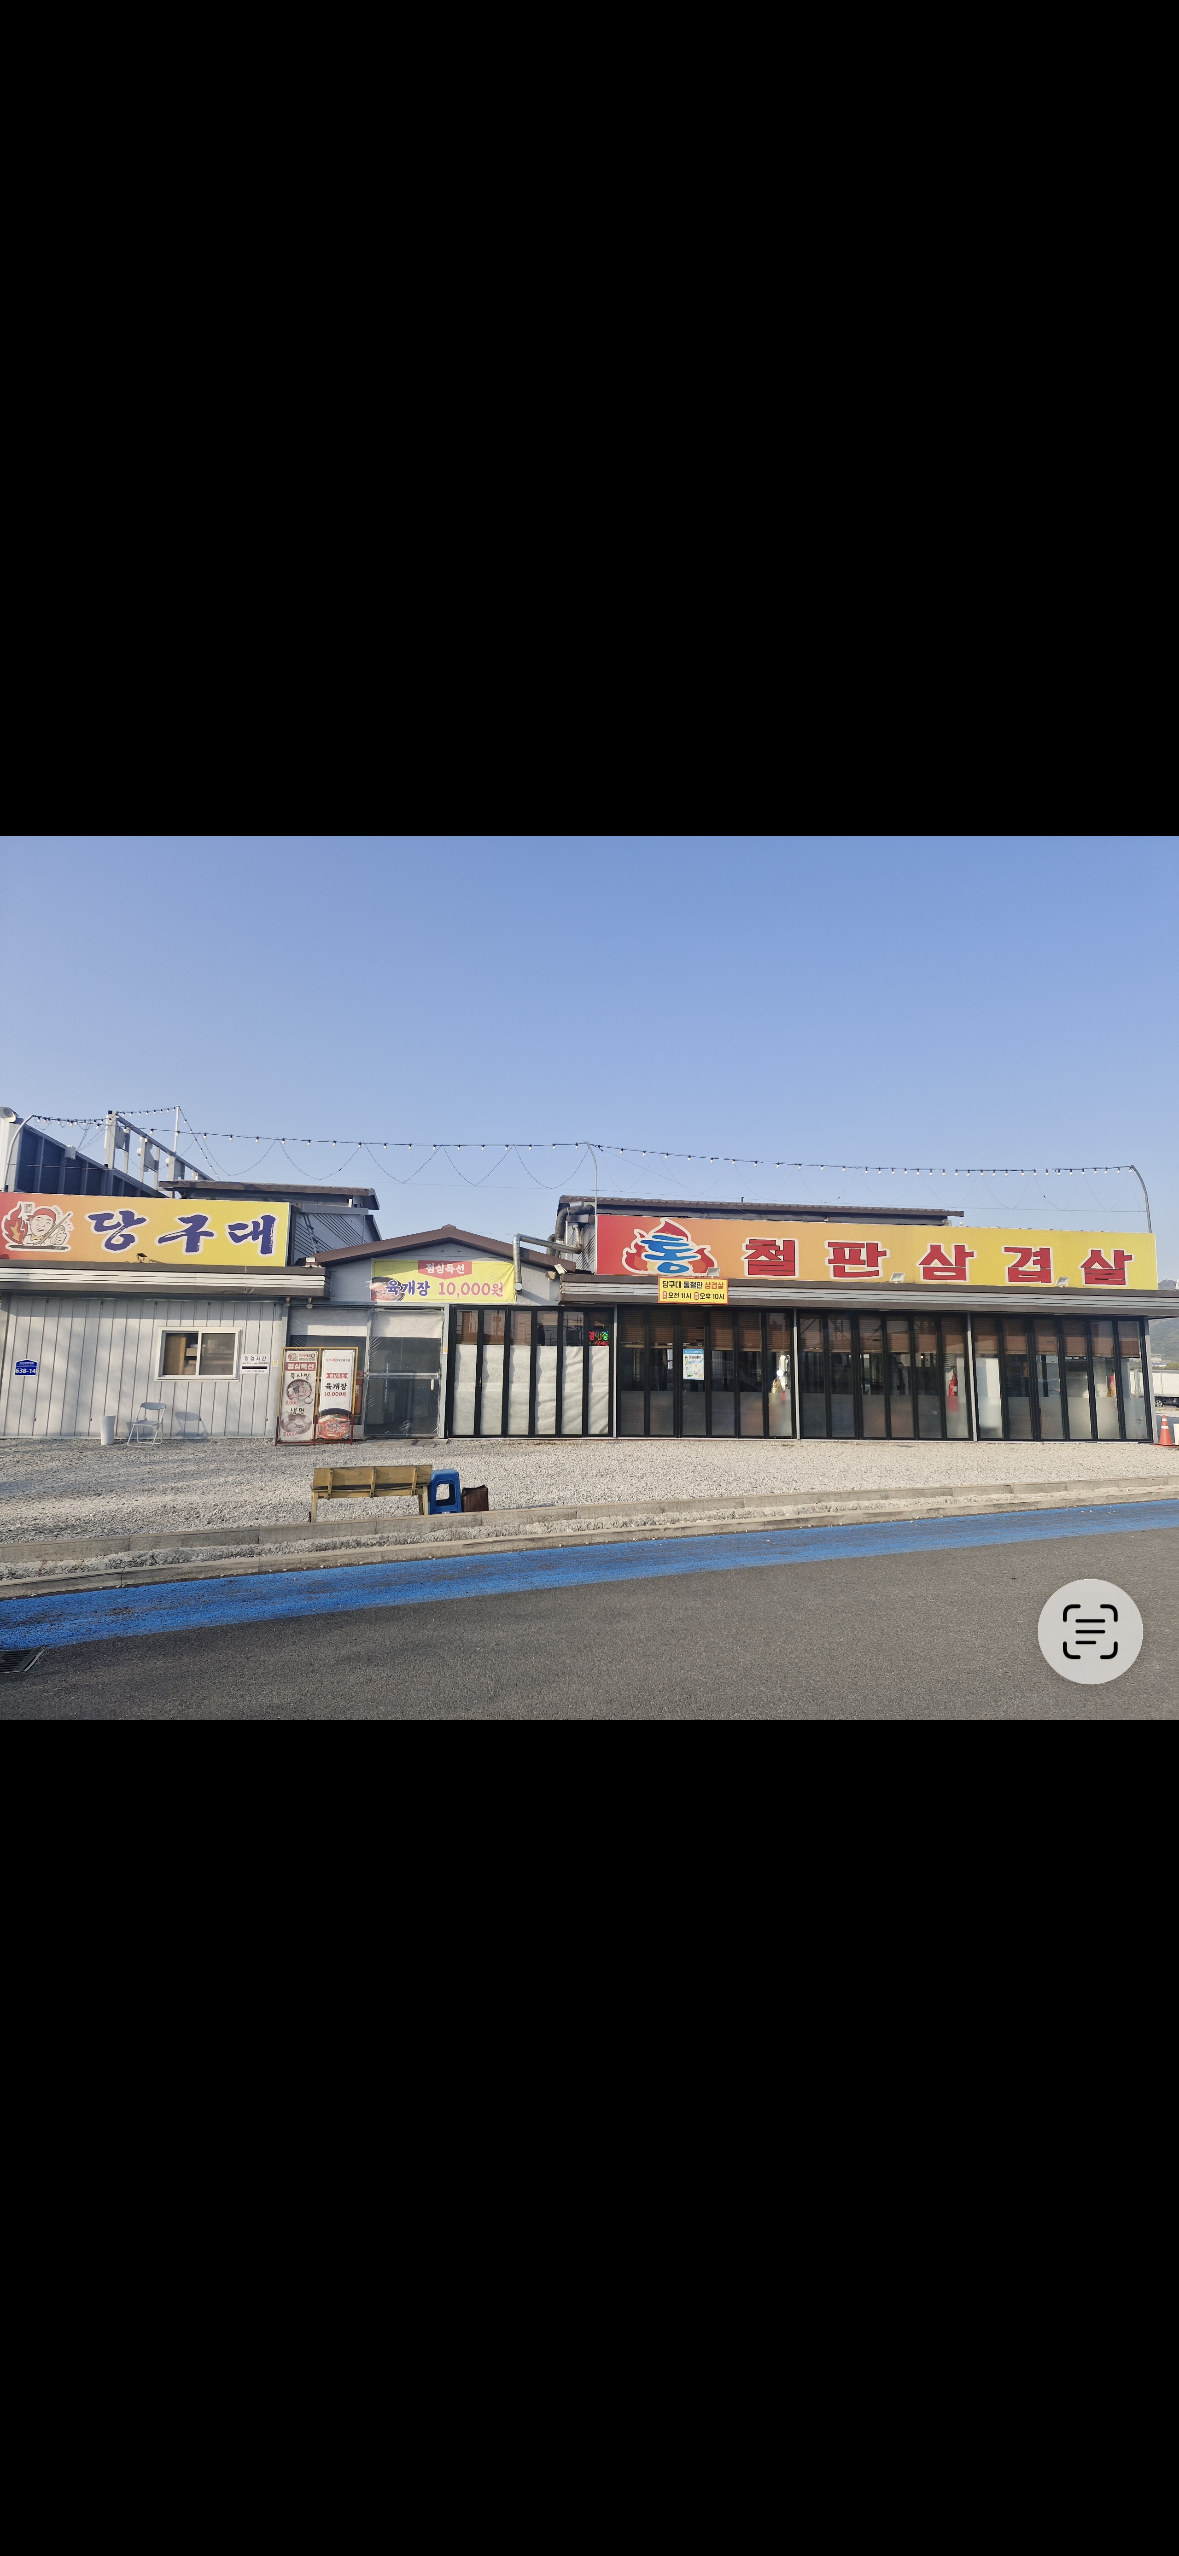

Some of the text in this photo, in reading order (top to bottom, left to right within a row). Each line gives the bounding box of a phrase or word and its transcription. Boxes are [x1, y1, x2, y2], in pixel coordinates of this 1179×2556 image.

[87, 1209, 277, 1256] 당구대
[639, 1233, 701, 1274] 통
[425, 1263, 465, 1275] 점심특선
[386, 1280, 504, 1298] 육개장 10,000원
[662, 1280, 681, 1289] 당구대
[704, 1282, 724, 1290] 삼겹살
[699, 1292, 711, 1300] 오후
[324, 1382, 348, 1391] 육개장
